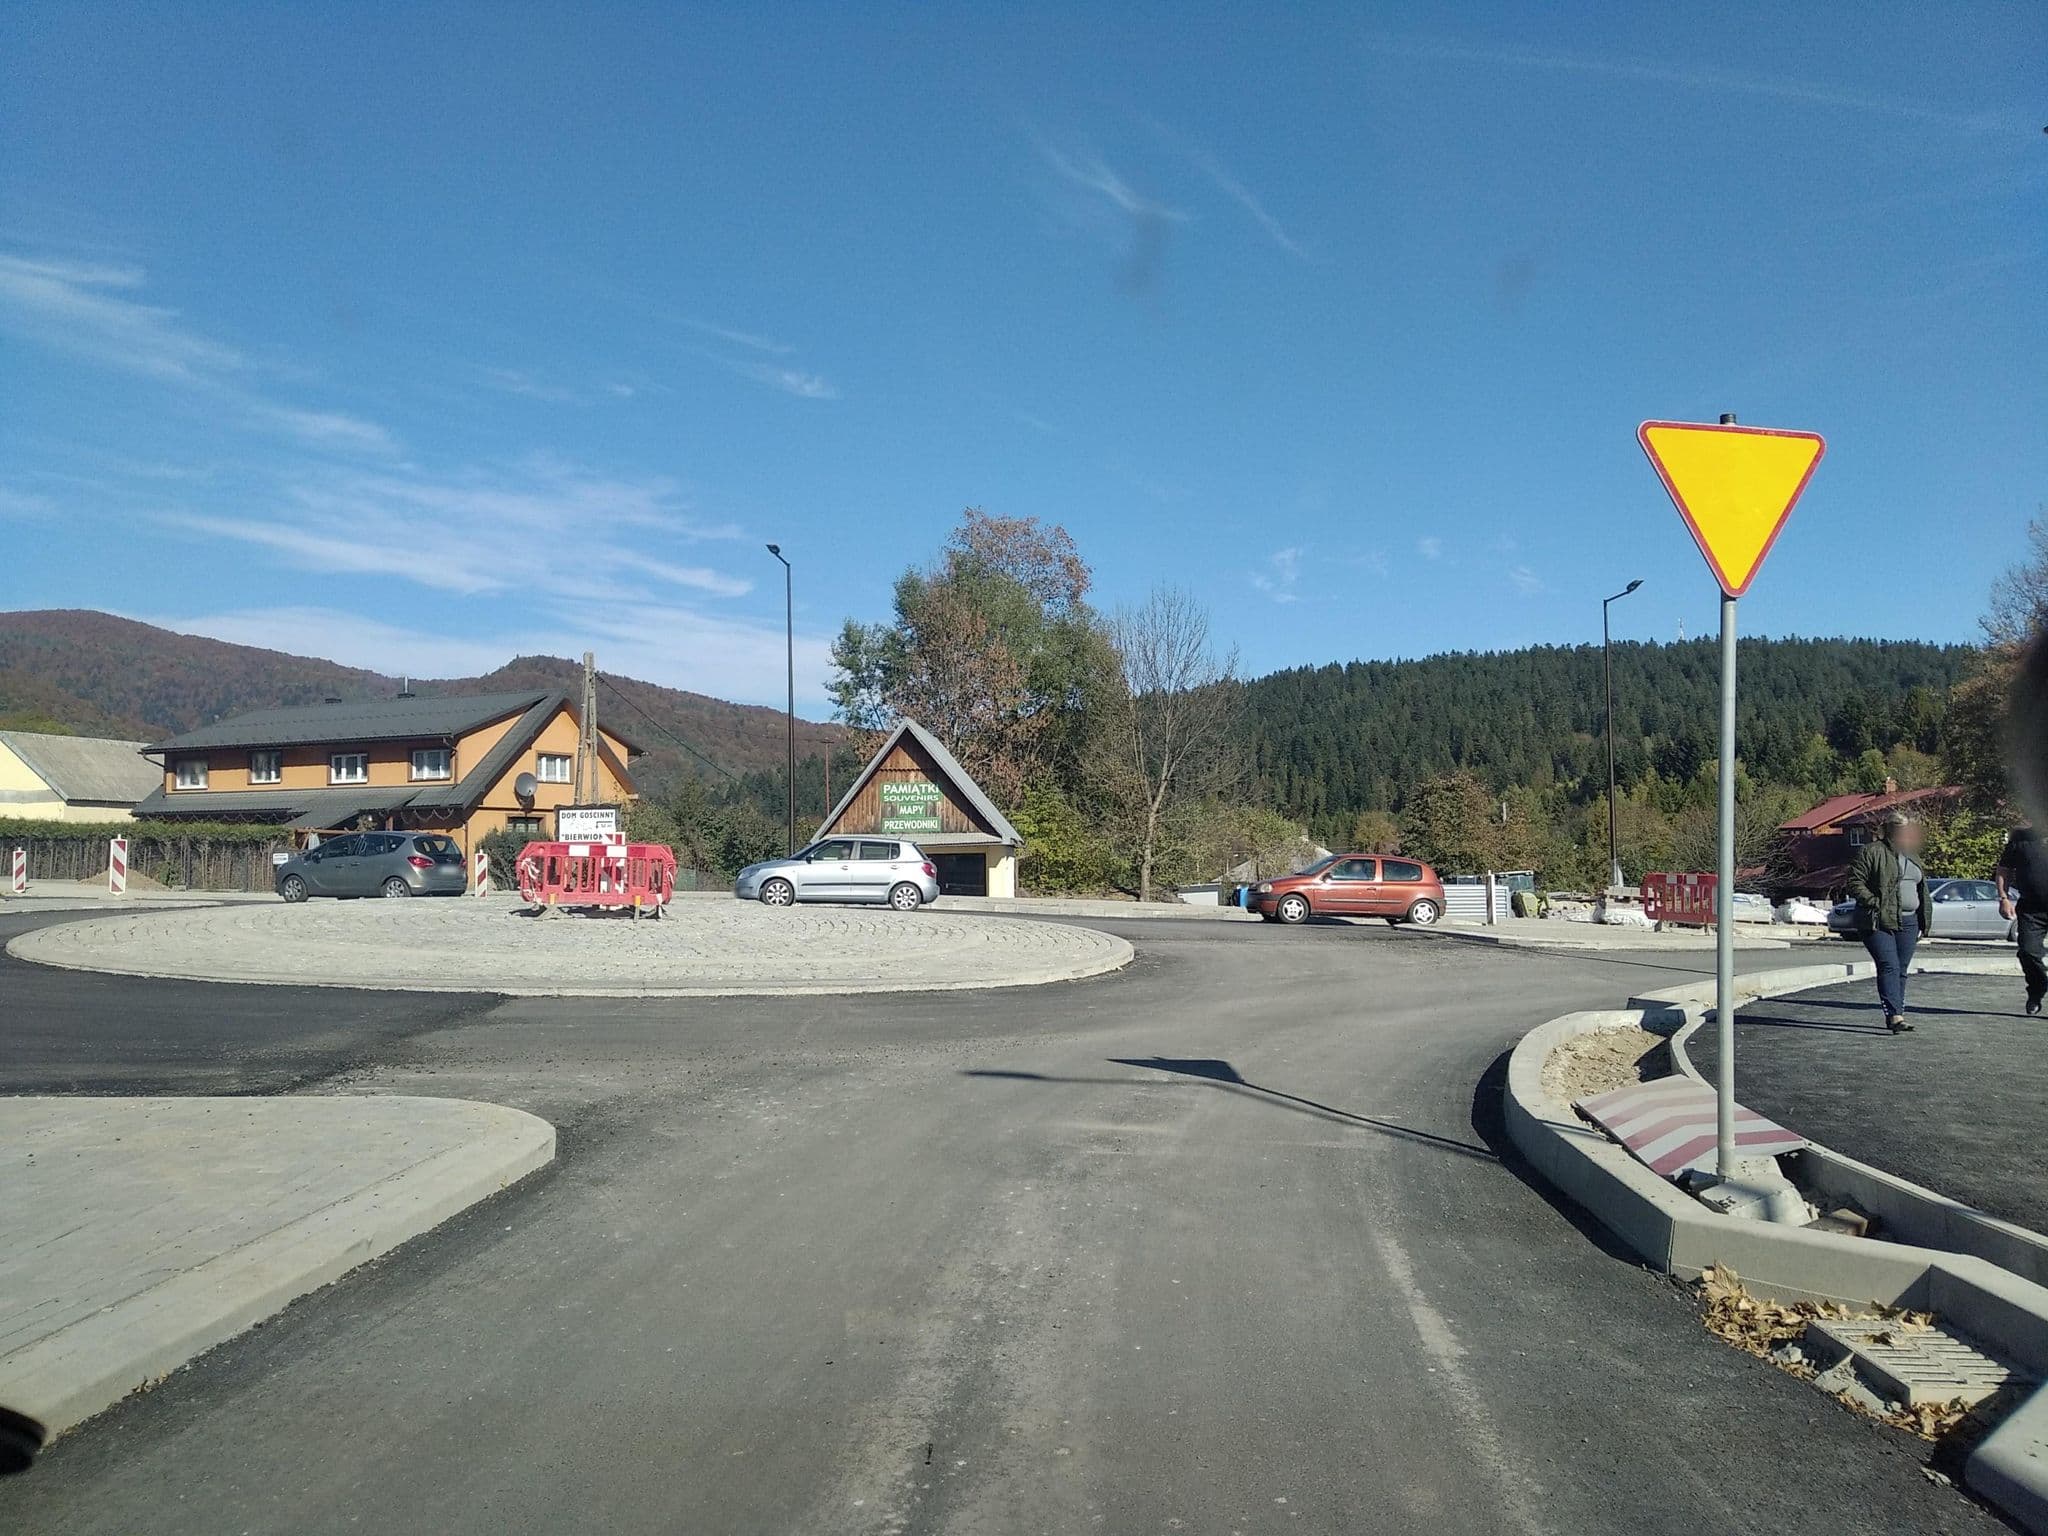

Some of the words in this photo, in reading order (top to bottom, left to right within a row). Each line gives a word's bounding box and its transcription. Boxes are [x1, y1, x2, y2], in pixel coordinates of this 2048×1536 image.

[883, 784, 939, 795] PAMIĄTKI
[899, 804, 924, 814] MAPY
[884, 819, 938, 829] PRZEWODNIKI
